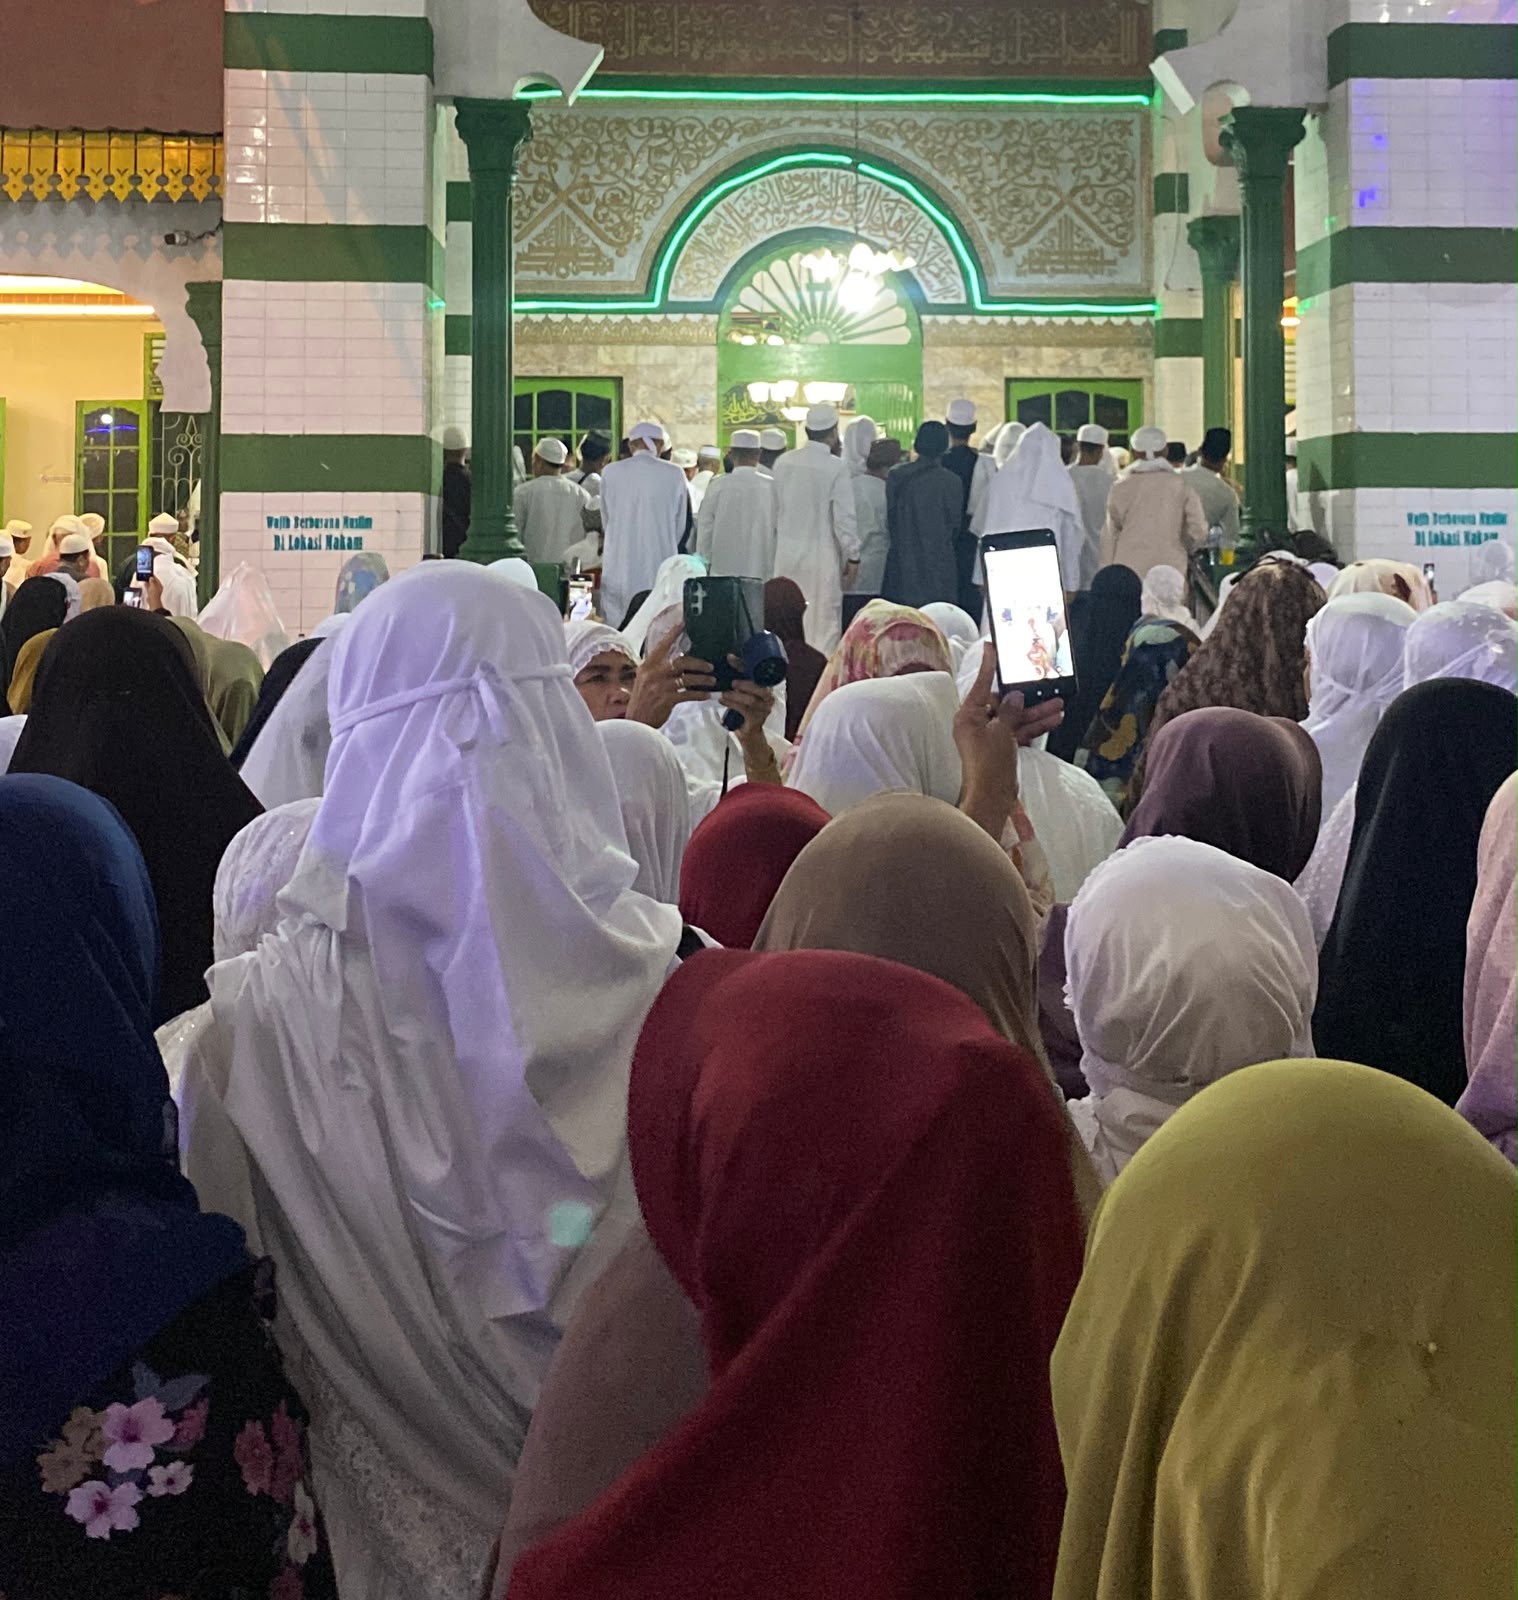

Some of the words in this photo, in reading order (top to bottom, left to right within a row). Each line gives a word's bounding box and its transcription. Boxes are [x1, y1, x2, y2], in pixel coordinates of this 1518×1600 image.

[267, 516, 290, 529] Wajib
[294, 516, 340, 529] Berbusana
[343, 516, 373, 529] Muslim
[274, 534, 285, 551] Di
[288, 534, 322, 551] Lokasi
[325, 534, 363, 551] Makam
[1415, 531, 1426, 546] Di
[1429, 531, 1460, 546] Lokasi
